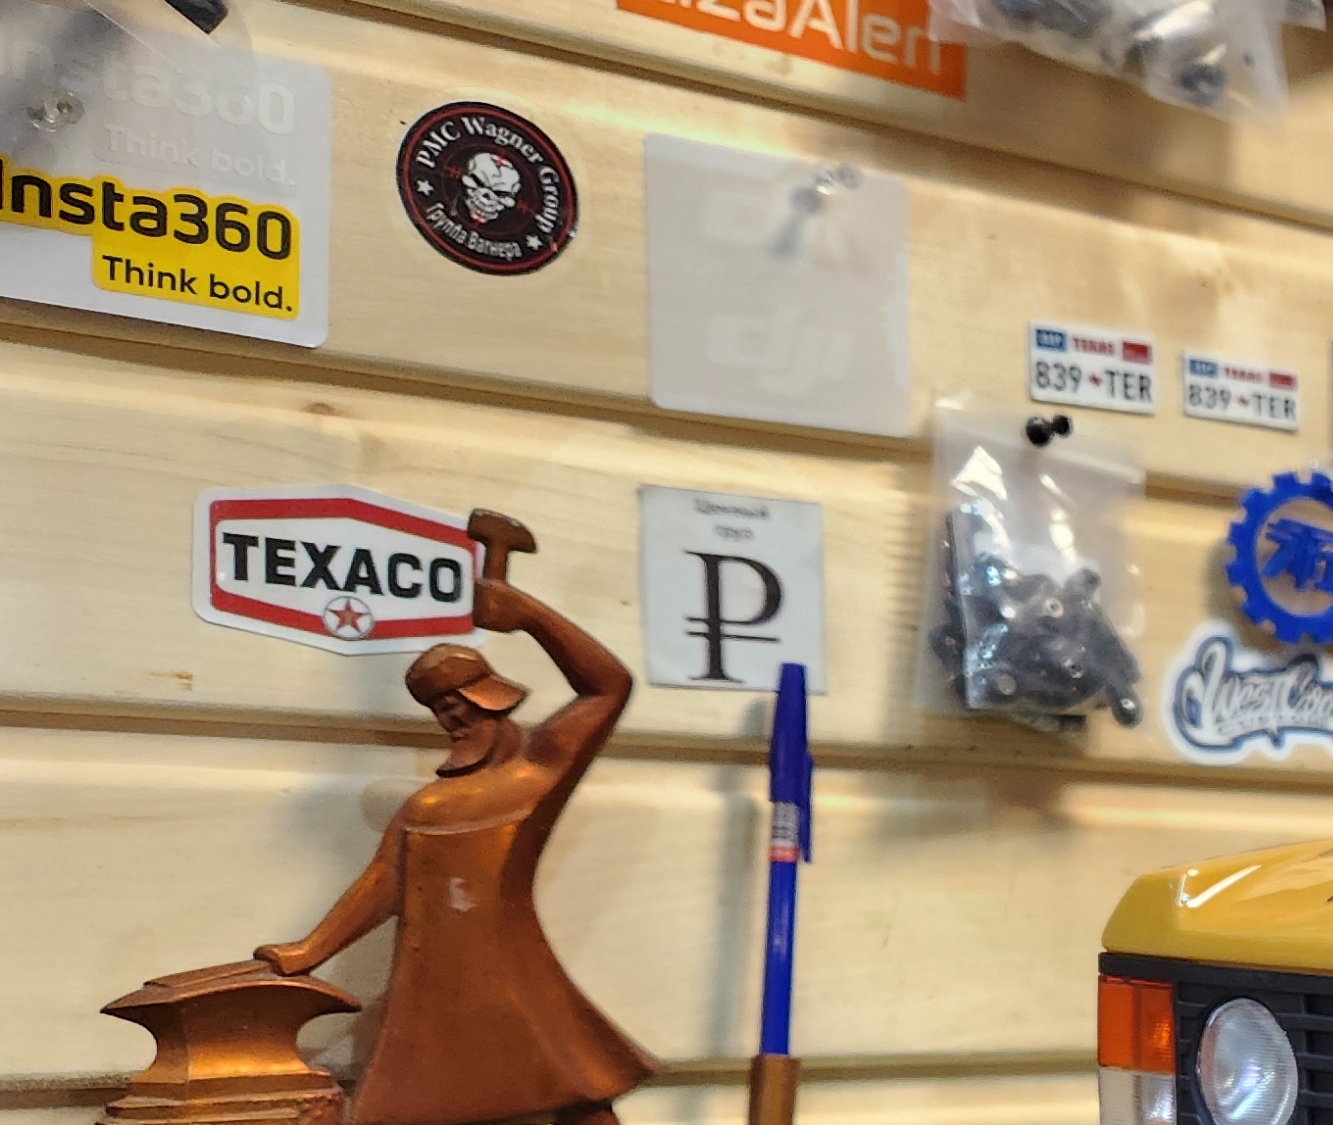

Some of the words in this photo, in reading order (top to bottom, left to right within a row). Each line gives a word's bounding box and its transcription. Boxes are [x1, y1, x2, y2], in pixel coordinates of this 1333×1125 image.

[415, 120, 462, 169] PMC
[460, 116, 544, 164] Wagner
[534, 165, 561, 235] Group
[0, 158, 292, 260] nsta360
[102, 254, 197, 294] Think
[209, 273, 292, 312] bold.
[1035, 361, 1083, 393] 839
[1103, 369, 1152, 402] TER
[1188, 383, 1232, 409] 839
[1252, 391, 1296, 420] TER
[221, 531, 464, 604] TEXACO
